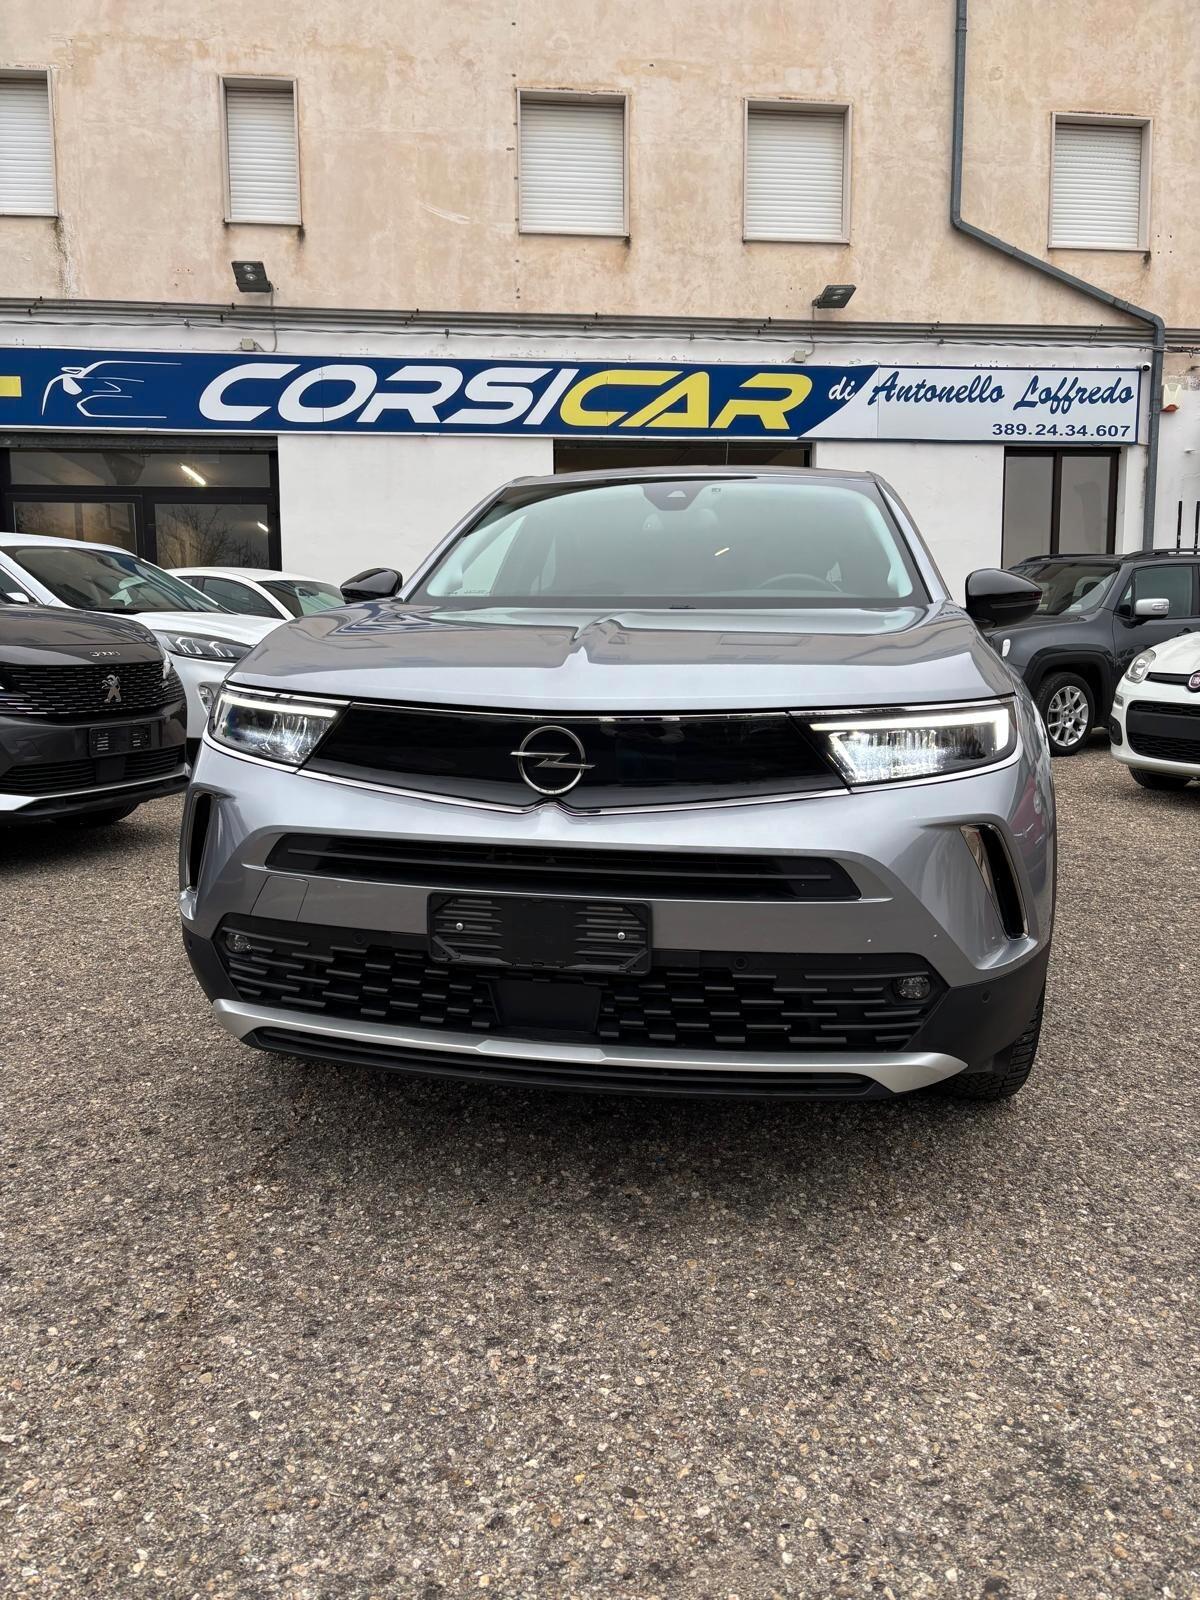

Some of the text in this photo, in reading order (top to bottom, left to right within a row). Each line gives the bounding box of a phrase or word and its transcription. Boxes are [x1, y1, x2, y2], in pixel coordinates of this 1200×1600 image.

[199, 363, 1134, 430] CORSICAR di Antonello Loffredo
[992, 423, 1131, 438] 389.24.34.607
